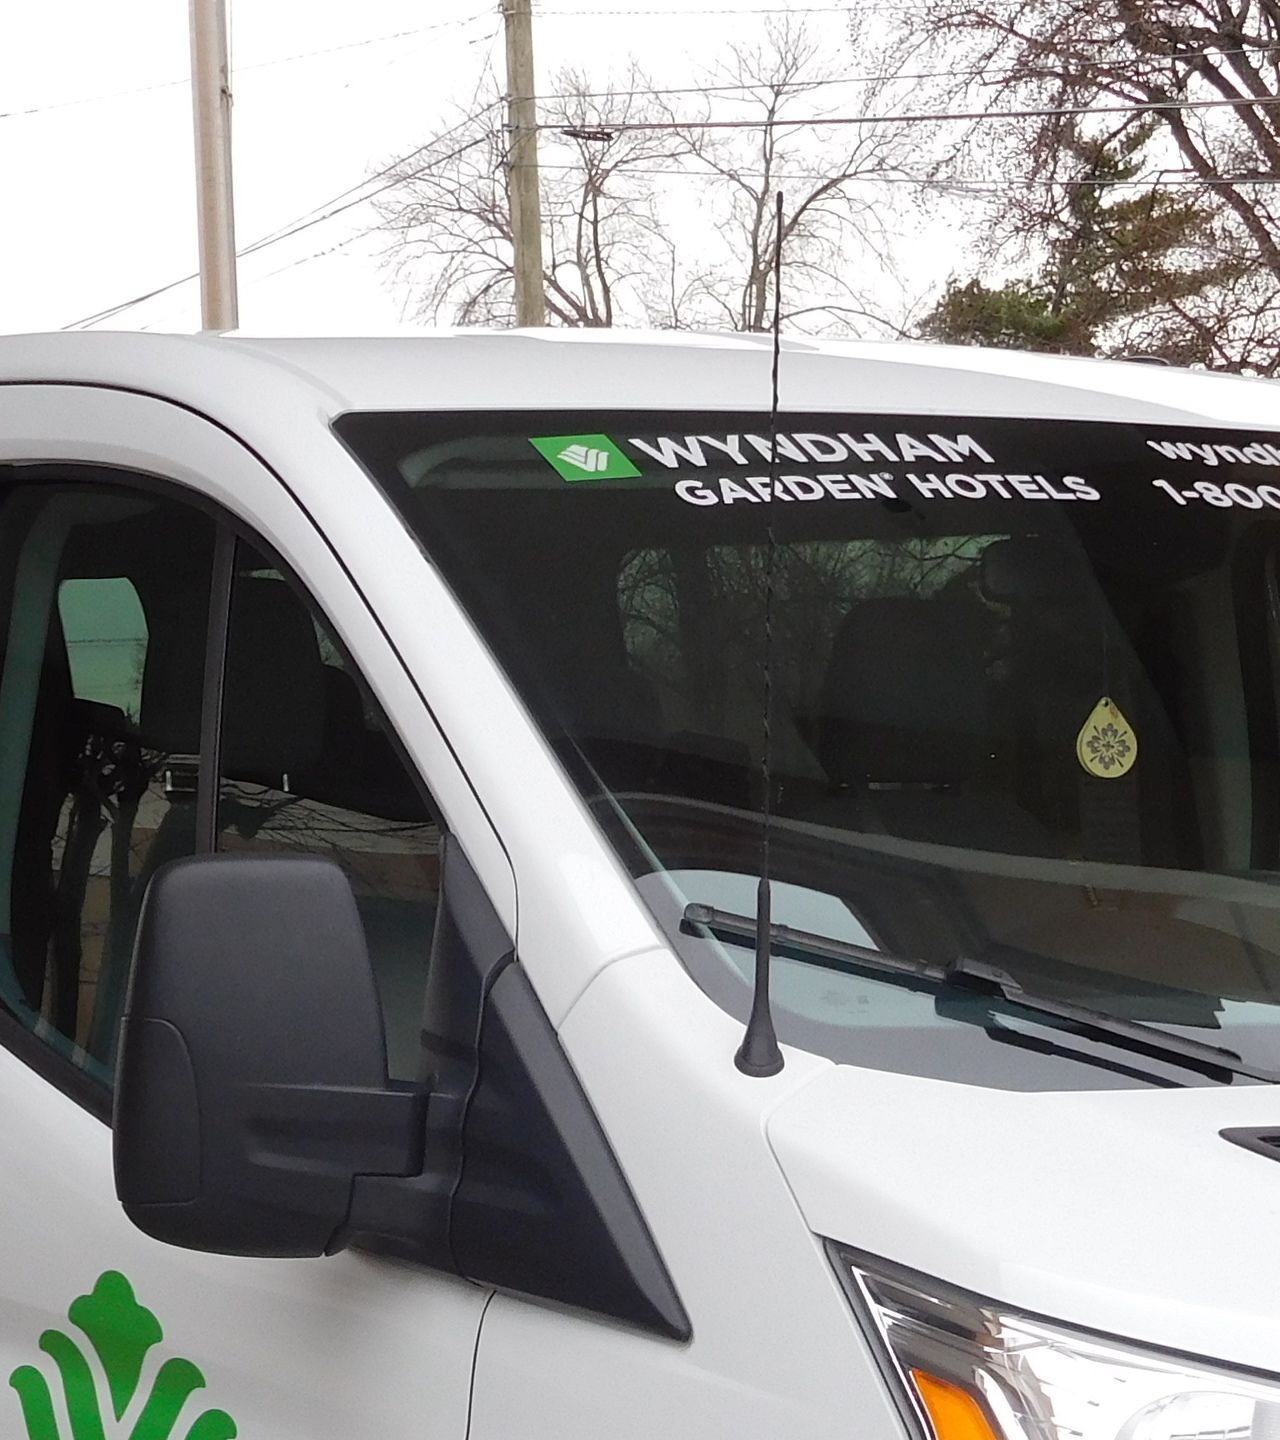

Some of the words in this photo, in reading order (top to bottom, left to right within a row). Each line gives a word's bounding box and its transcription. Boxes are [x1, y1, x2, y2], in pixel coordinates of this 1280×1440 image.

[628, 433, 995, 469] WYNDHAM
[674, 473, 890, 505] GARDEN
[905, 473, 1101, 502] HOTELS
